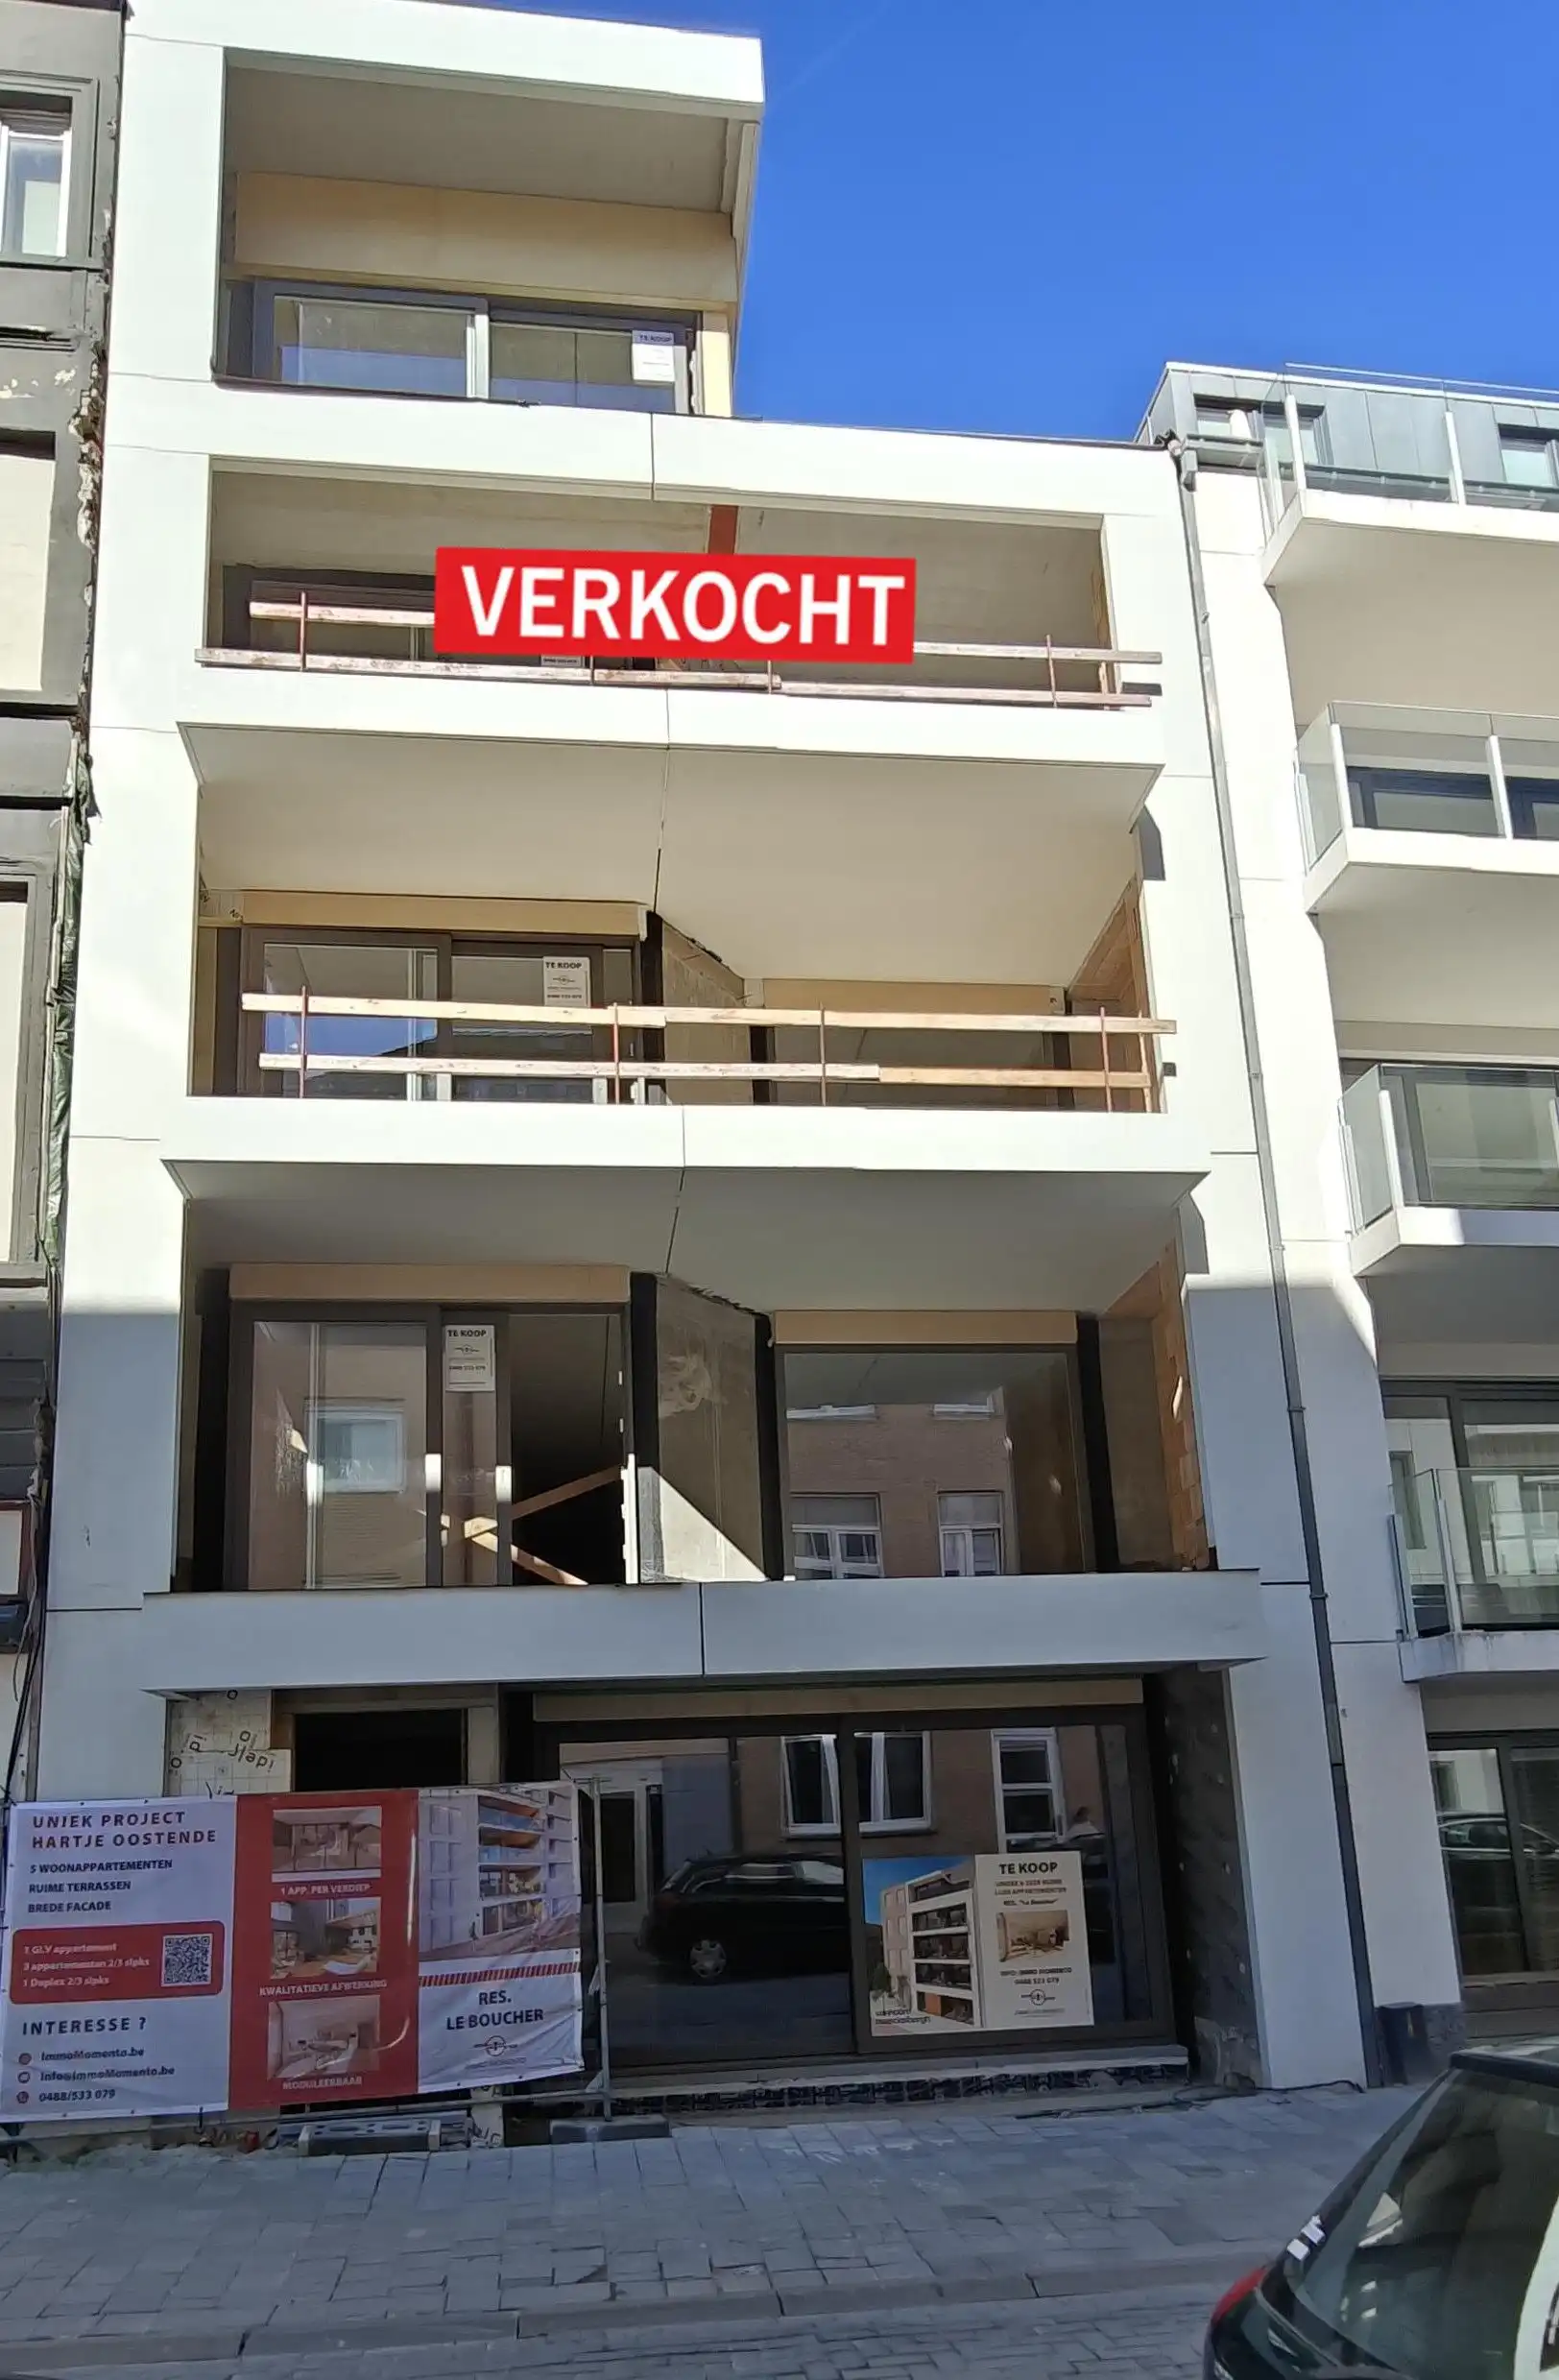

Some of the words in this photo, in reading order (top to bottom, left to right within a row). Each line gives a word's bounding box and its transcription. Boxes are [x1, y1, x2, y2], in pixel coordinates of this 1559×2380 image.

[447, 1329, 459, 1337] TE
[461, 1329, 487, 1337] KOOP
[33, 1815, 93, 1829] UNIEK
[101, 1811, 185, 1827] PROJECT
[32, 1834, 105, 1850] HARTJE
[112, 1830, 217, 1848] OOSTENDE
[39, 1859, 173, 1874] WOONAPPARTEMENTEN
[999, 1863, 1016, 1875] TE
[1018, 1863, 1058, 1874] KOOP
[29, 1883, 64, 1894] RUIME
[67, 1880, 132, 1892] TERRASSEN
[28, 1903, 64, 1914] BREDE
[66, 1900, 112, 1912] FACADE
[54, 1942, 117, 1956] appartement
[479, 1989, 513, 2006] RES.
[22, 2016, 132, 2036] INTERESSE
[138, 2016, 147, 2031] ?
[446, 2015, 466, 2031] LE
[468, 2007, 545, 2029] BOUCHER
[38, 2090, 94, 2103] 0488/533
[95, 2088, 116, 2101] 079
